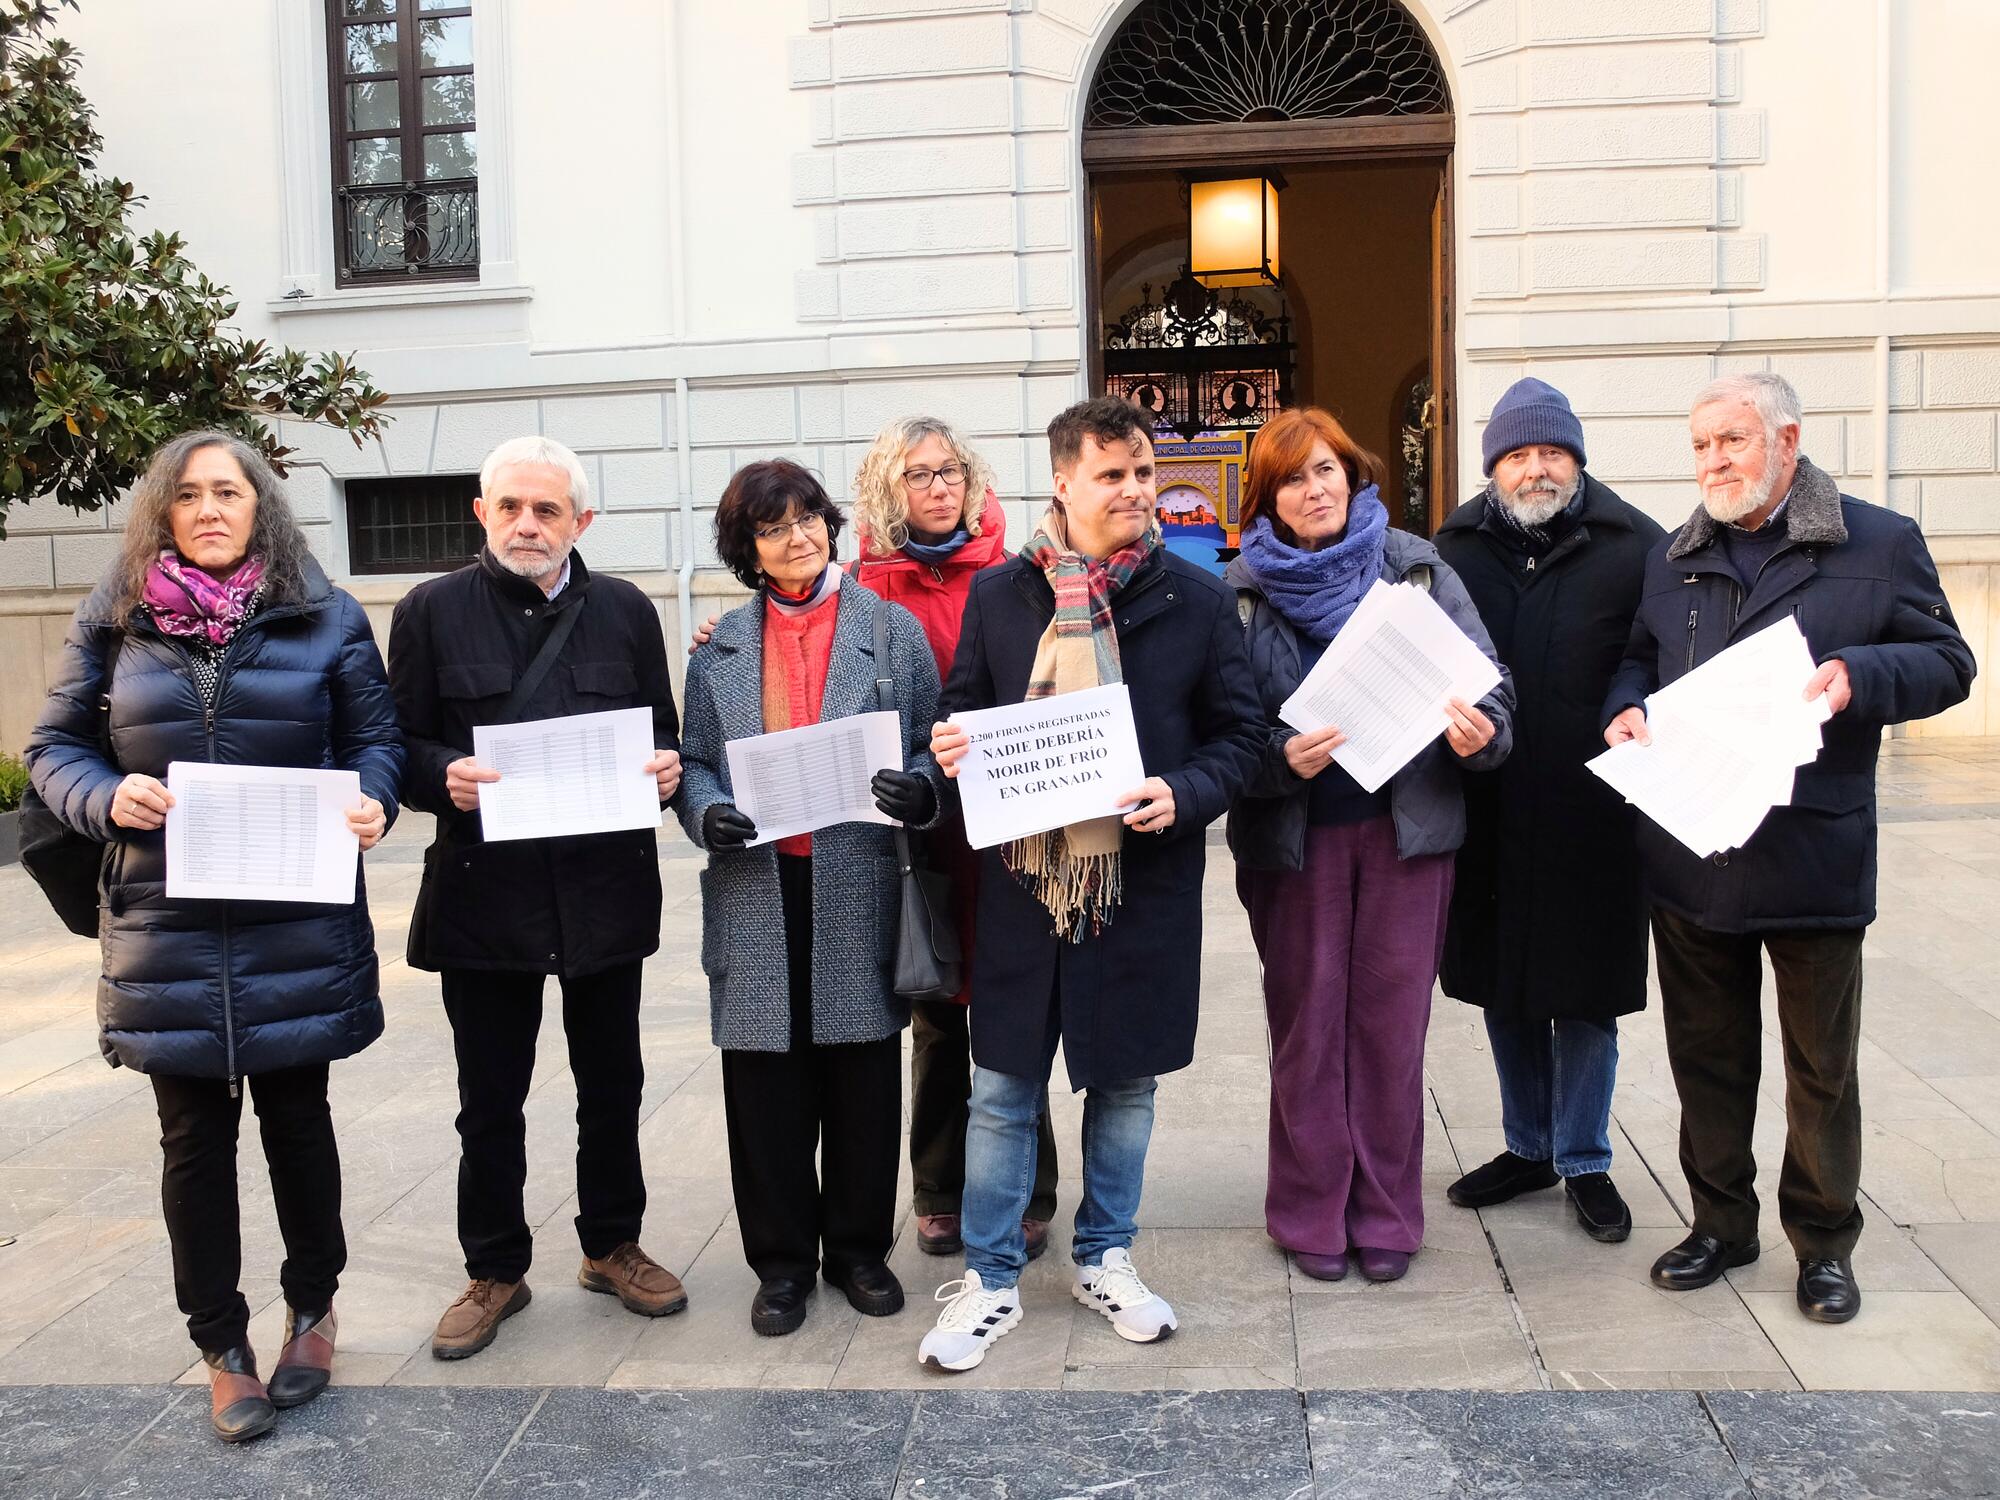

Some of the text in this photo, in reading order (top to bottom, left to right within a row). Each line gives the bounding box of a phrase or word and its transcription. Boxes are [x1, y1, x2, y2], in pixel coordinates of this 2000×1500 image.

[1154, 444, 1238, 455] UNICIPAL DE GRANADA
[995, 724, 1036, 739] FIRMAS
[1037, 708, 1111, 730] REGISTRADAS
[982, 725, 1105, 761] NADIE DEBERÍA
[986, 747, 1108, 781] MORIR DE FRÍO
[1000, 769, 1103, 800] EN GRANADA
